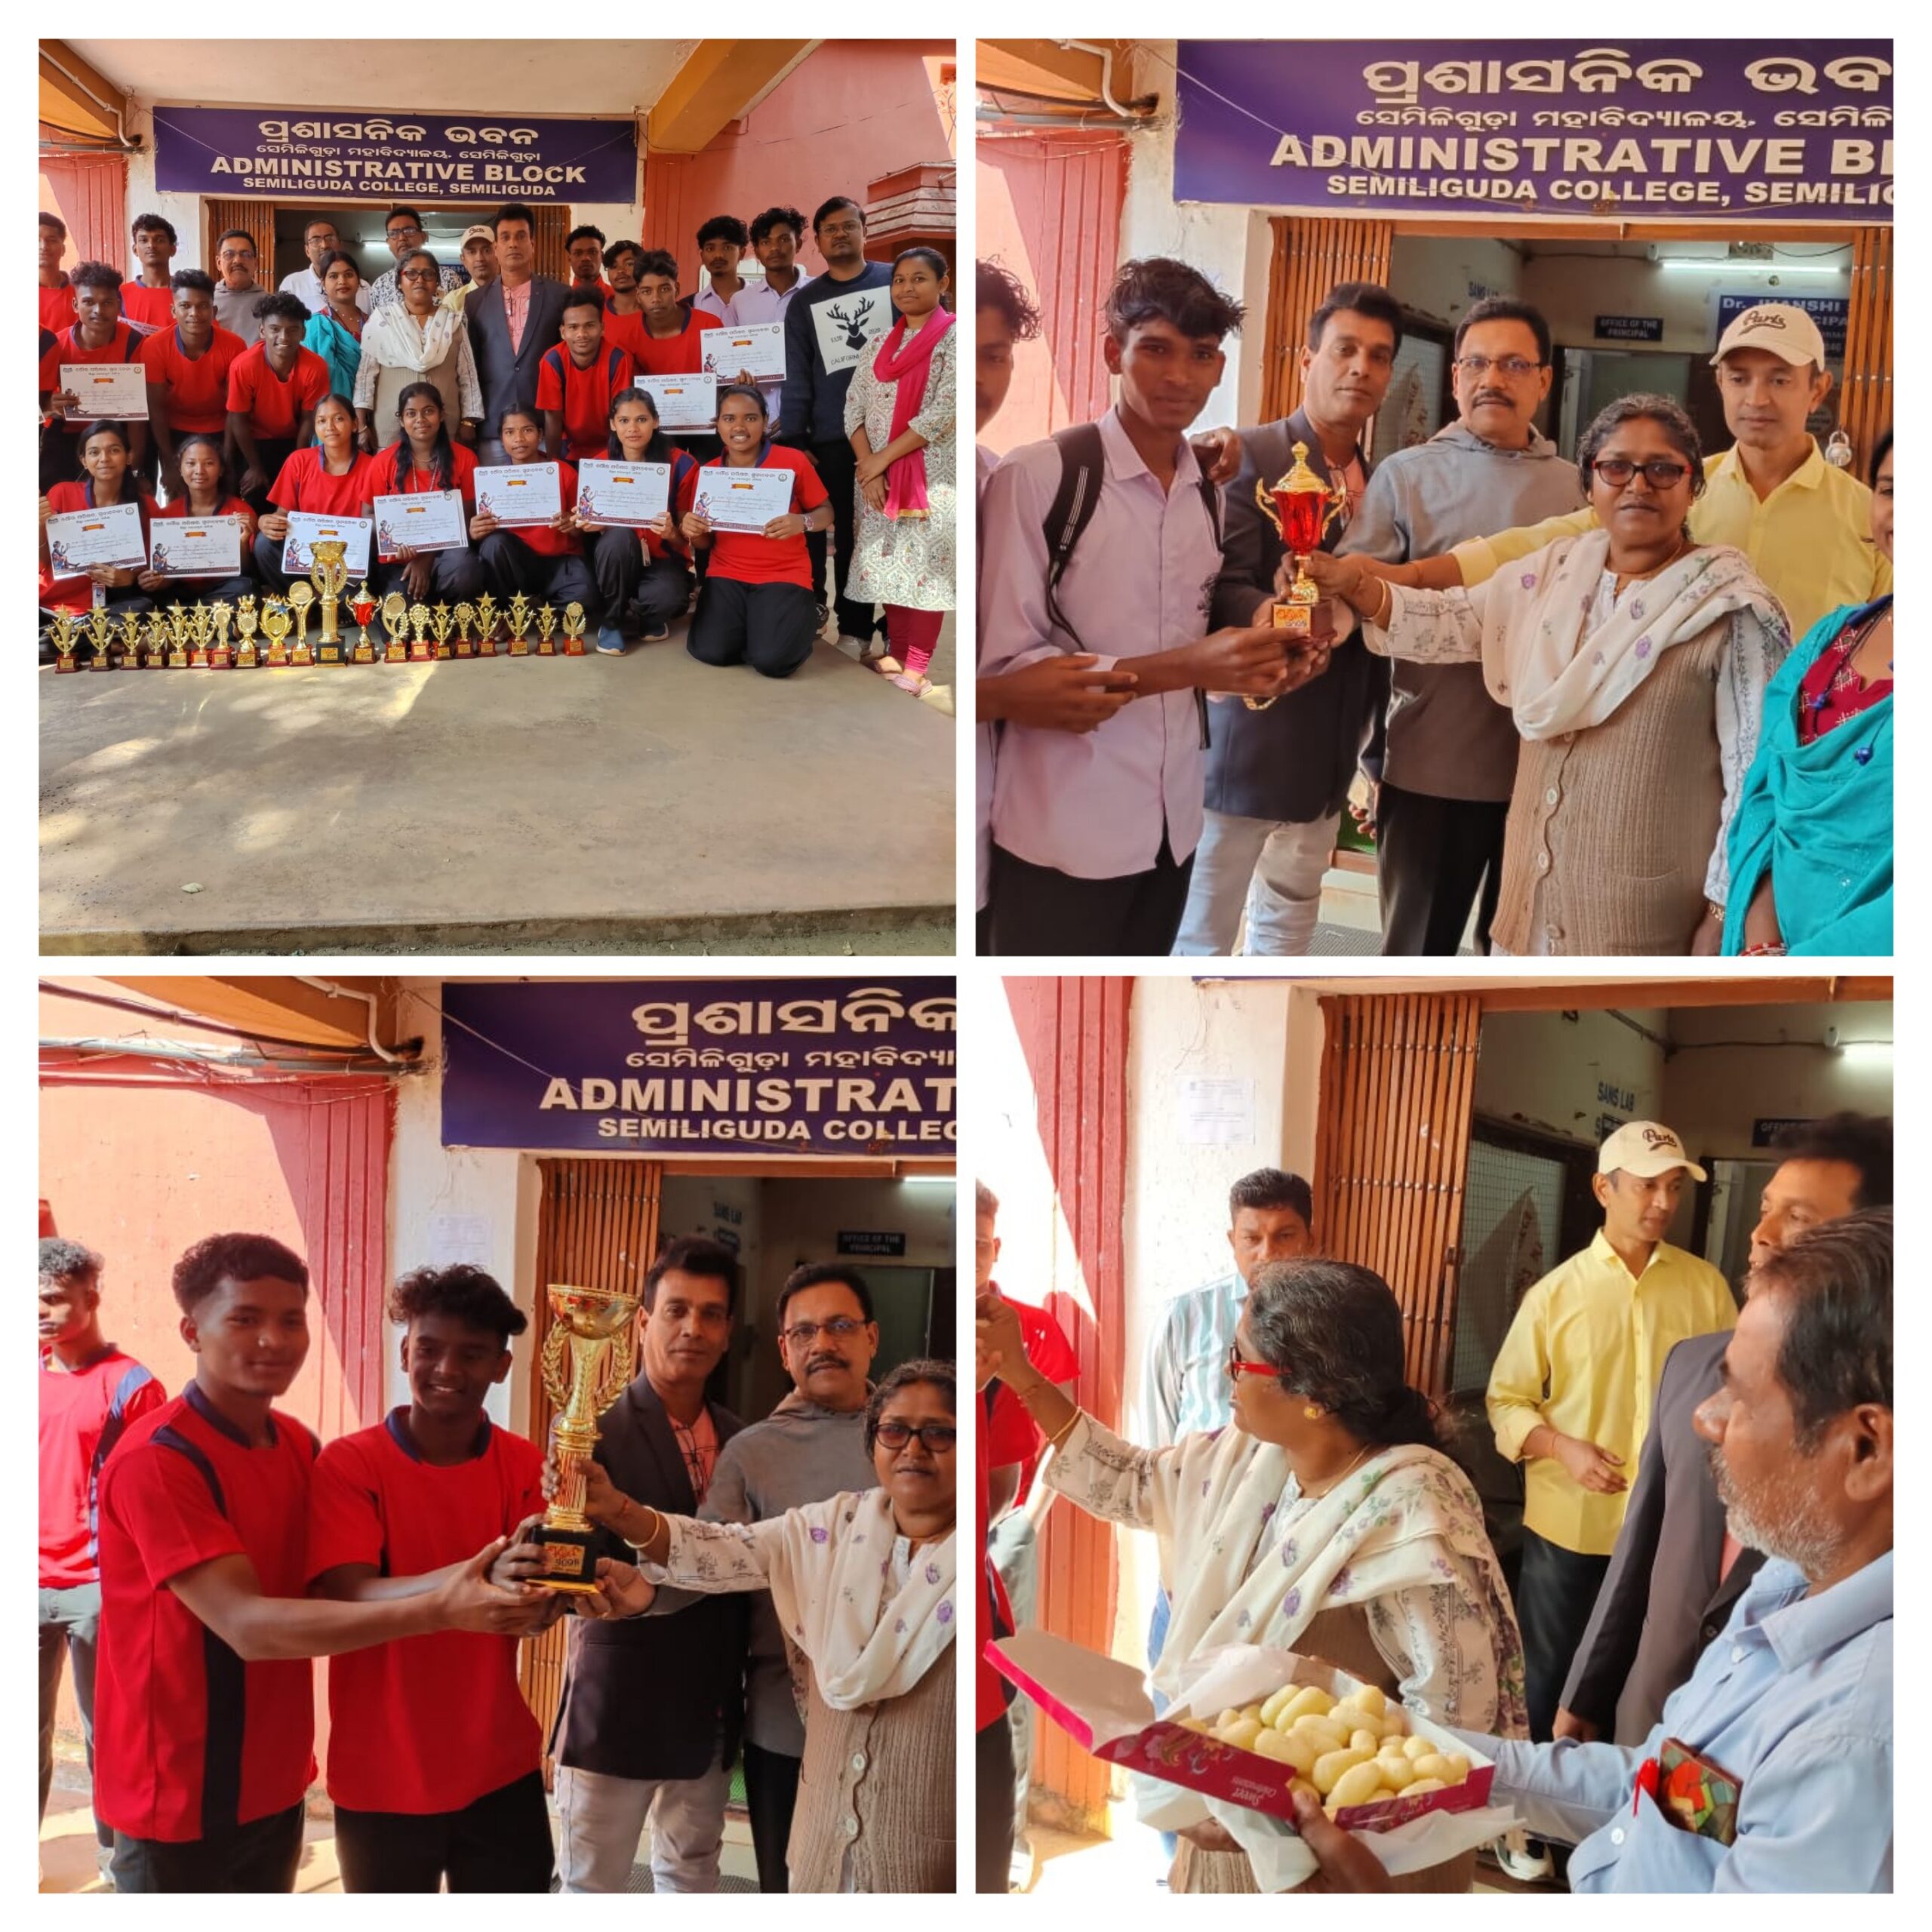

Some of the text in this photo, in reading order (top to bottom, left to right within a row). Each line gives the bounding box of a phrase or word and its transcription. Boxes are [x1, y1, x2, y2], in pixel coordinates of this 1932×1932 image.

[1362, 48, 1892, 104] ପ୍ରଶାସନିକ ଭବ
[258, 118, 539, 145] ପ୍ରଶାସନିକ ଭବନ
[1269, 134, 1806, 174] ADMINISTRATIVE
[211, 156, 586, 183] ADMINISTRATIVE BLOCK
[243, 177, 555, 195] SEMILIGUDA COLLEGE, SEMILIGUDA
[1327, 174, 1538, 199] SEMILIGUDA
[1549, 180, 1730, 207] COLLEGE,
[1722, 297, 1746, 309] Dr.
[540, 1078, 957, 1112] ADMINISTRAT
[598, 1118, 811, 1140] SEMILIGUDA
